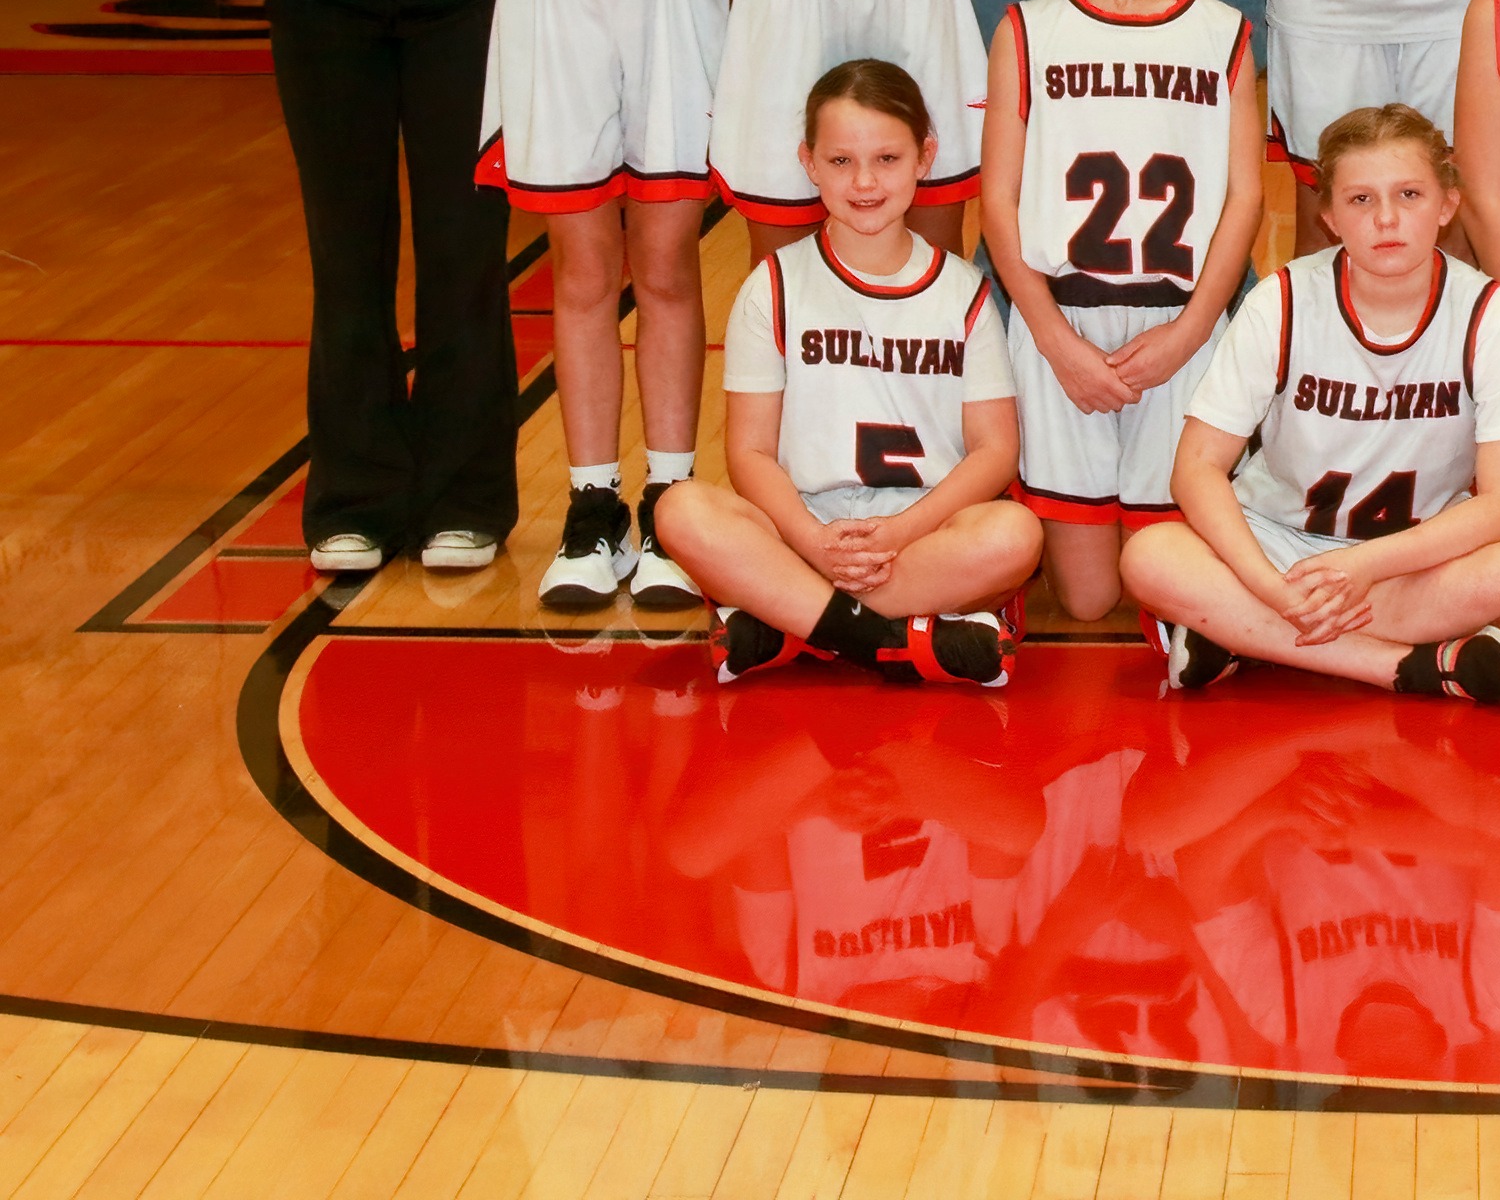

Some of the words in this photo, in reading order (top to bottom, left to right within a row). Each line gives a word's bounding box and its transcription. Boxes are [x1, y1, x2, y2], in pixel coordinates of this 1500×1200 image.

[1044, 62, 1219, 107] SULLIVAN
[1065, 150, 1196, 283] 22
[1304, 469, 1422, 541] 14
